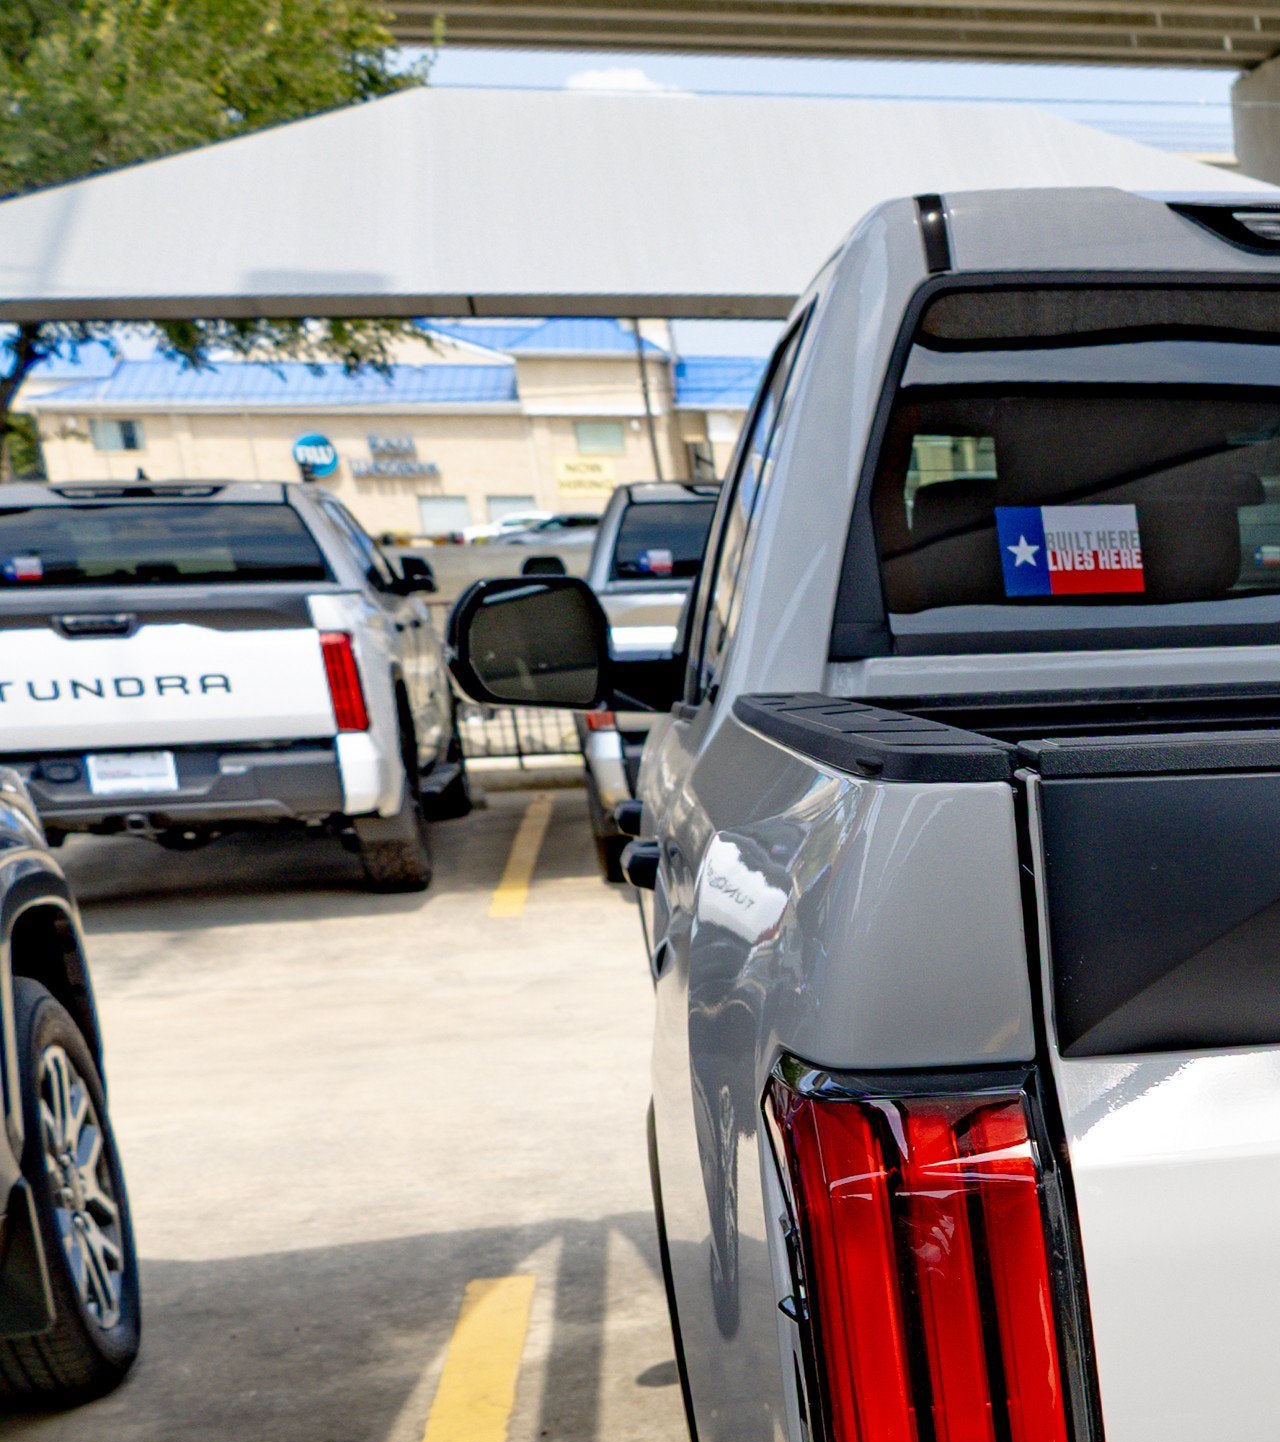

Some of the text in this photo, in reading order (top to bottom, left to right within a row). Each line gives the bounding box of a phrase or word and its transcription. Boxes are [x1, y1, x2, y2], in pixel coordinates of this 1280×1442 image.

[1046, 530, 1139, 551] BUILT HERE
[1048, 549, 1143, 571] LIVES HERE
